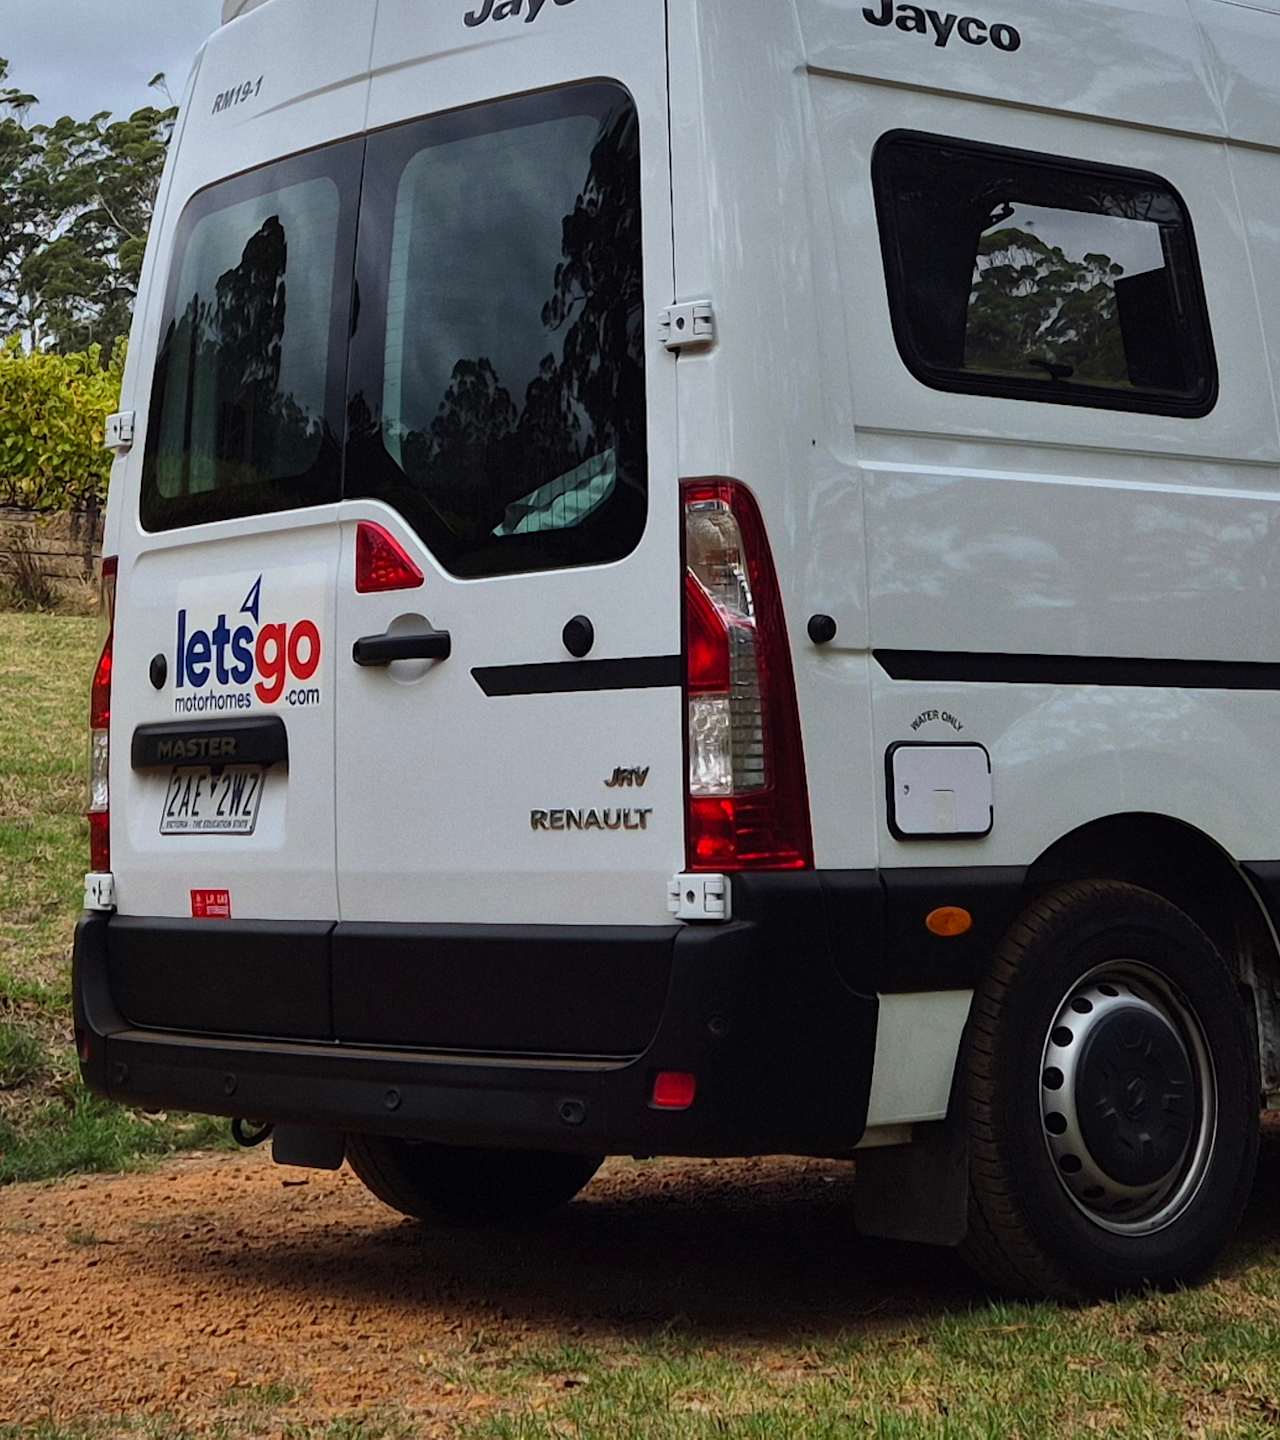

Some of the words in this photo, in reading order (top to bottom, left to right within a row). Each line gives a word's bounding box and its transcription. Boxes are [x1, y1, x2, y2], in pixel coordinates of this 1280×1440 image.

[211, 75, 264, 115] RM19-1
[175, 689, 252, 712] motorhomes
[910, 709, 940, 731] WATER
[941, 711, 964, 732] ONLY
[157, 736, 237, 760] MASTER
[530, 808, 653, 830] RENAULT
